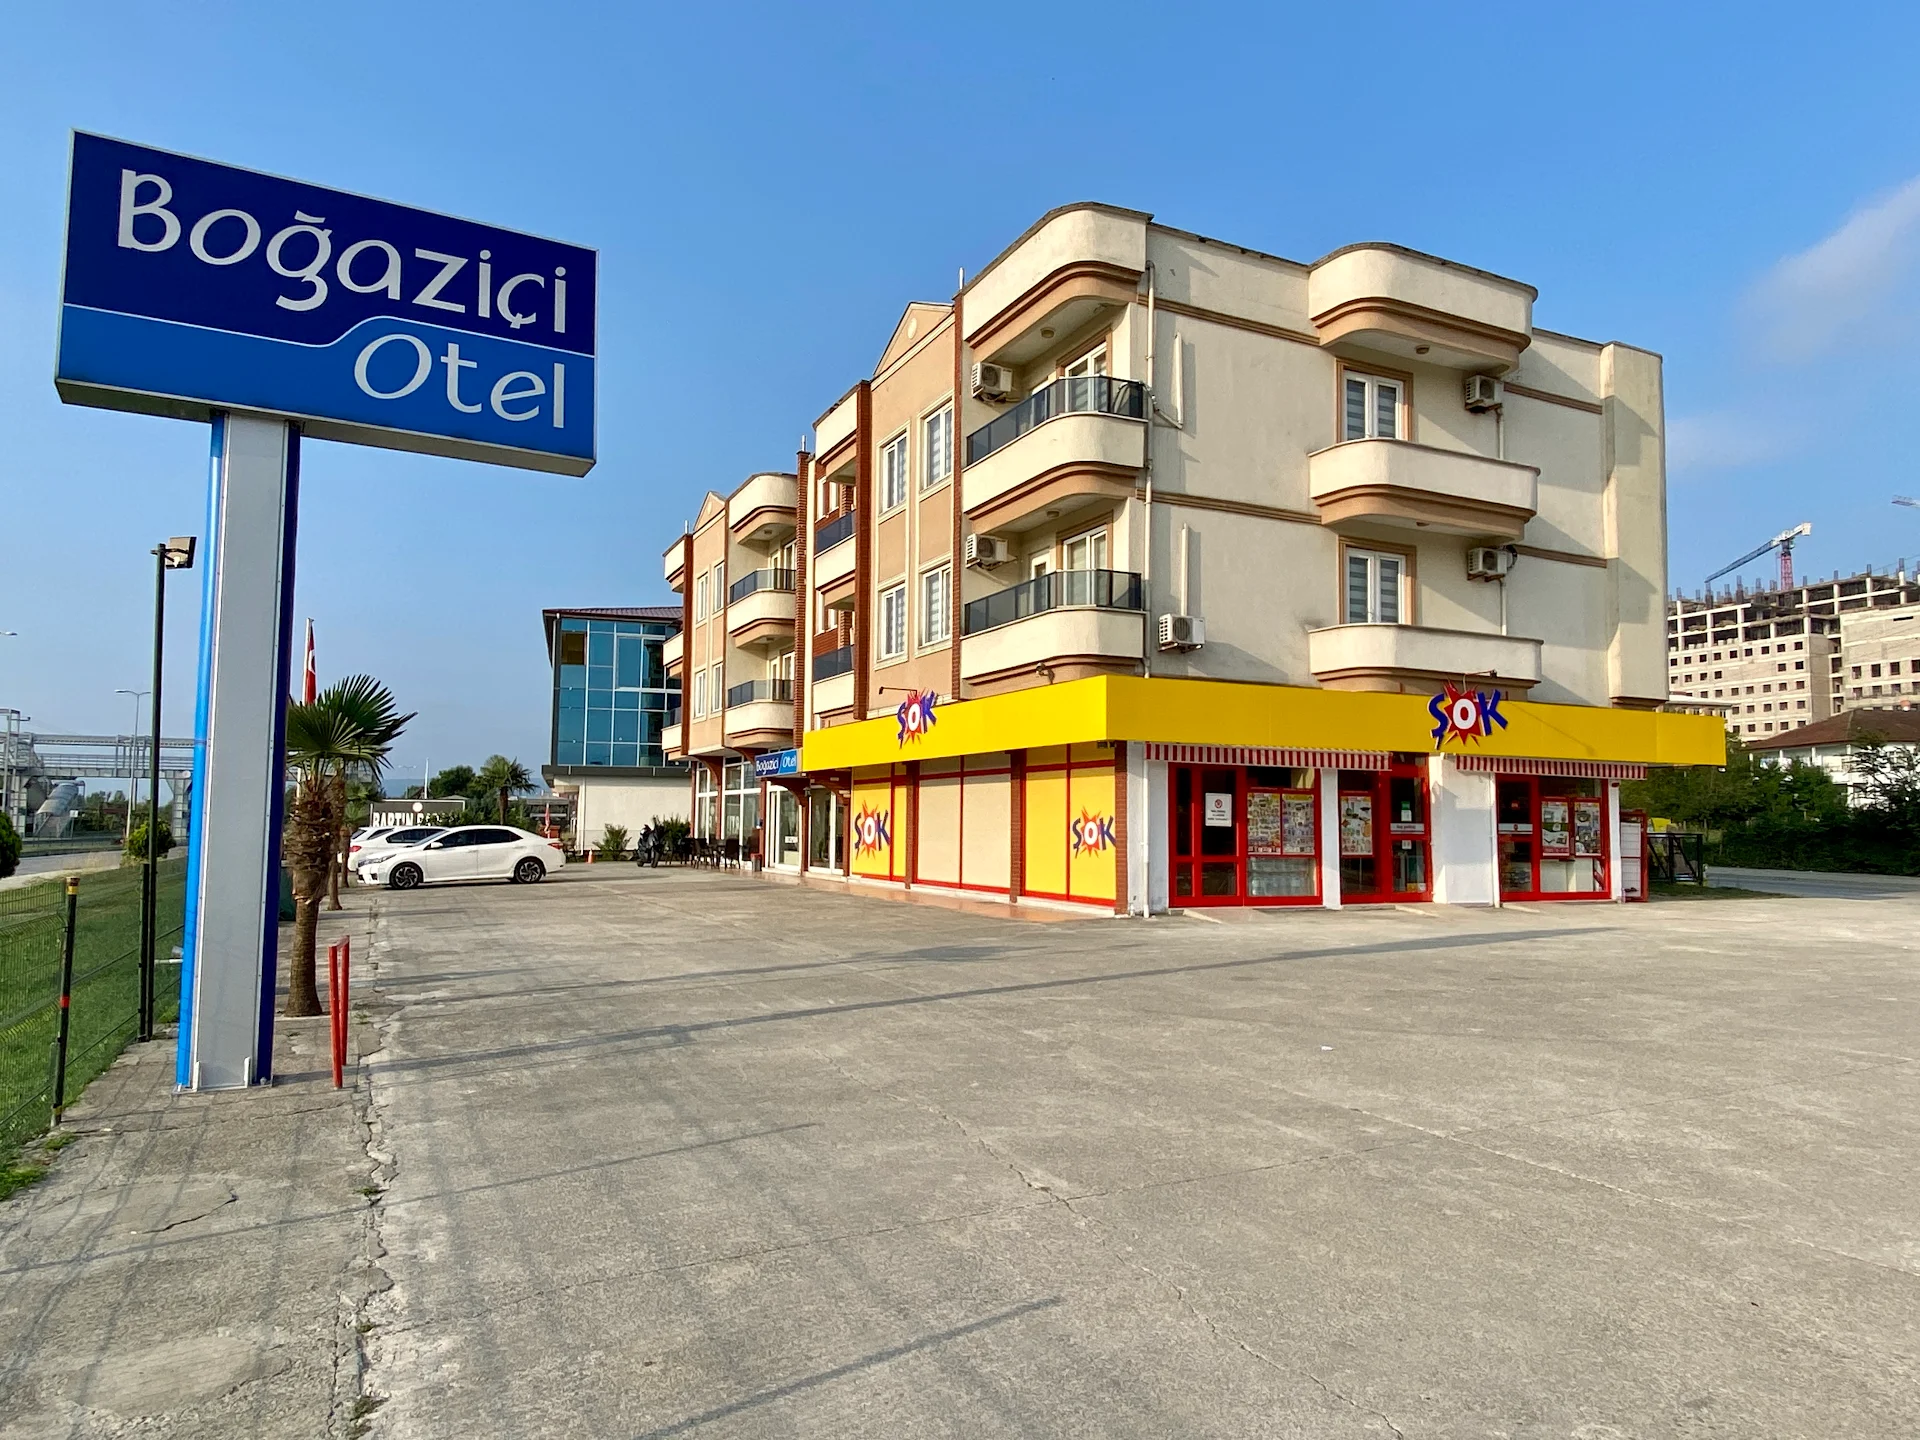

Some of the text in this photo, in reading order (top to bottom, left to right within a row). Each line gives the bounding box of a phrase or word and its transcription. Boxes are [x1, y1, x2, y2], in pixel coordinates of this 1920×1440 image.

[117, 168, 567, 334] Boğaziçi
[353, 333, 565, 429] Otel
[896, 689, 938, 750] ŞOK
[1427, 688, 1508, 750] ŞOK
[782, 754, 797, 768] Otel
[854, 808, 891, 860] ŞOK
[1072, 814, 1117, 859] ŞOK
